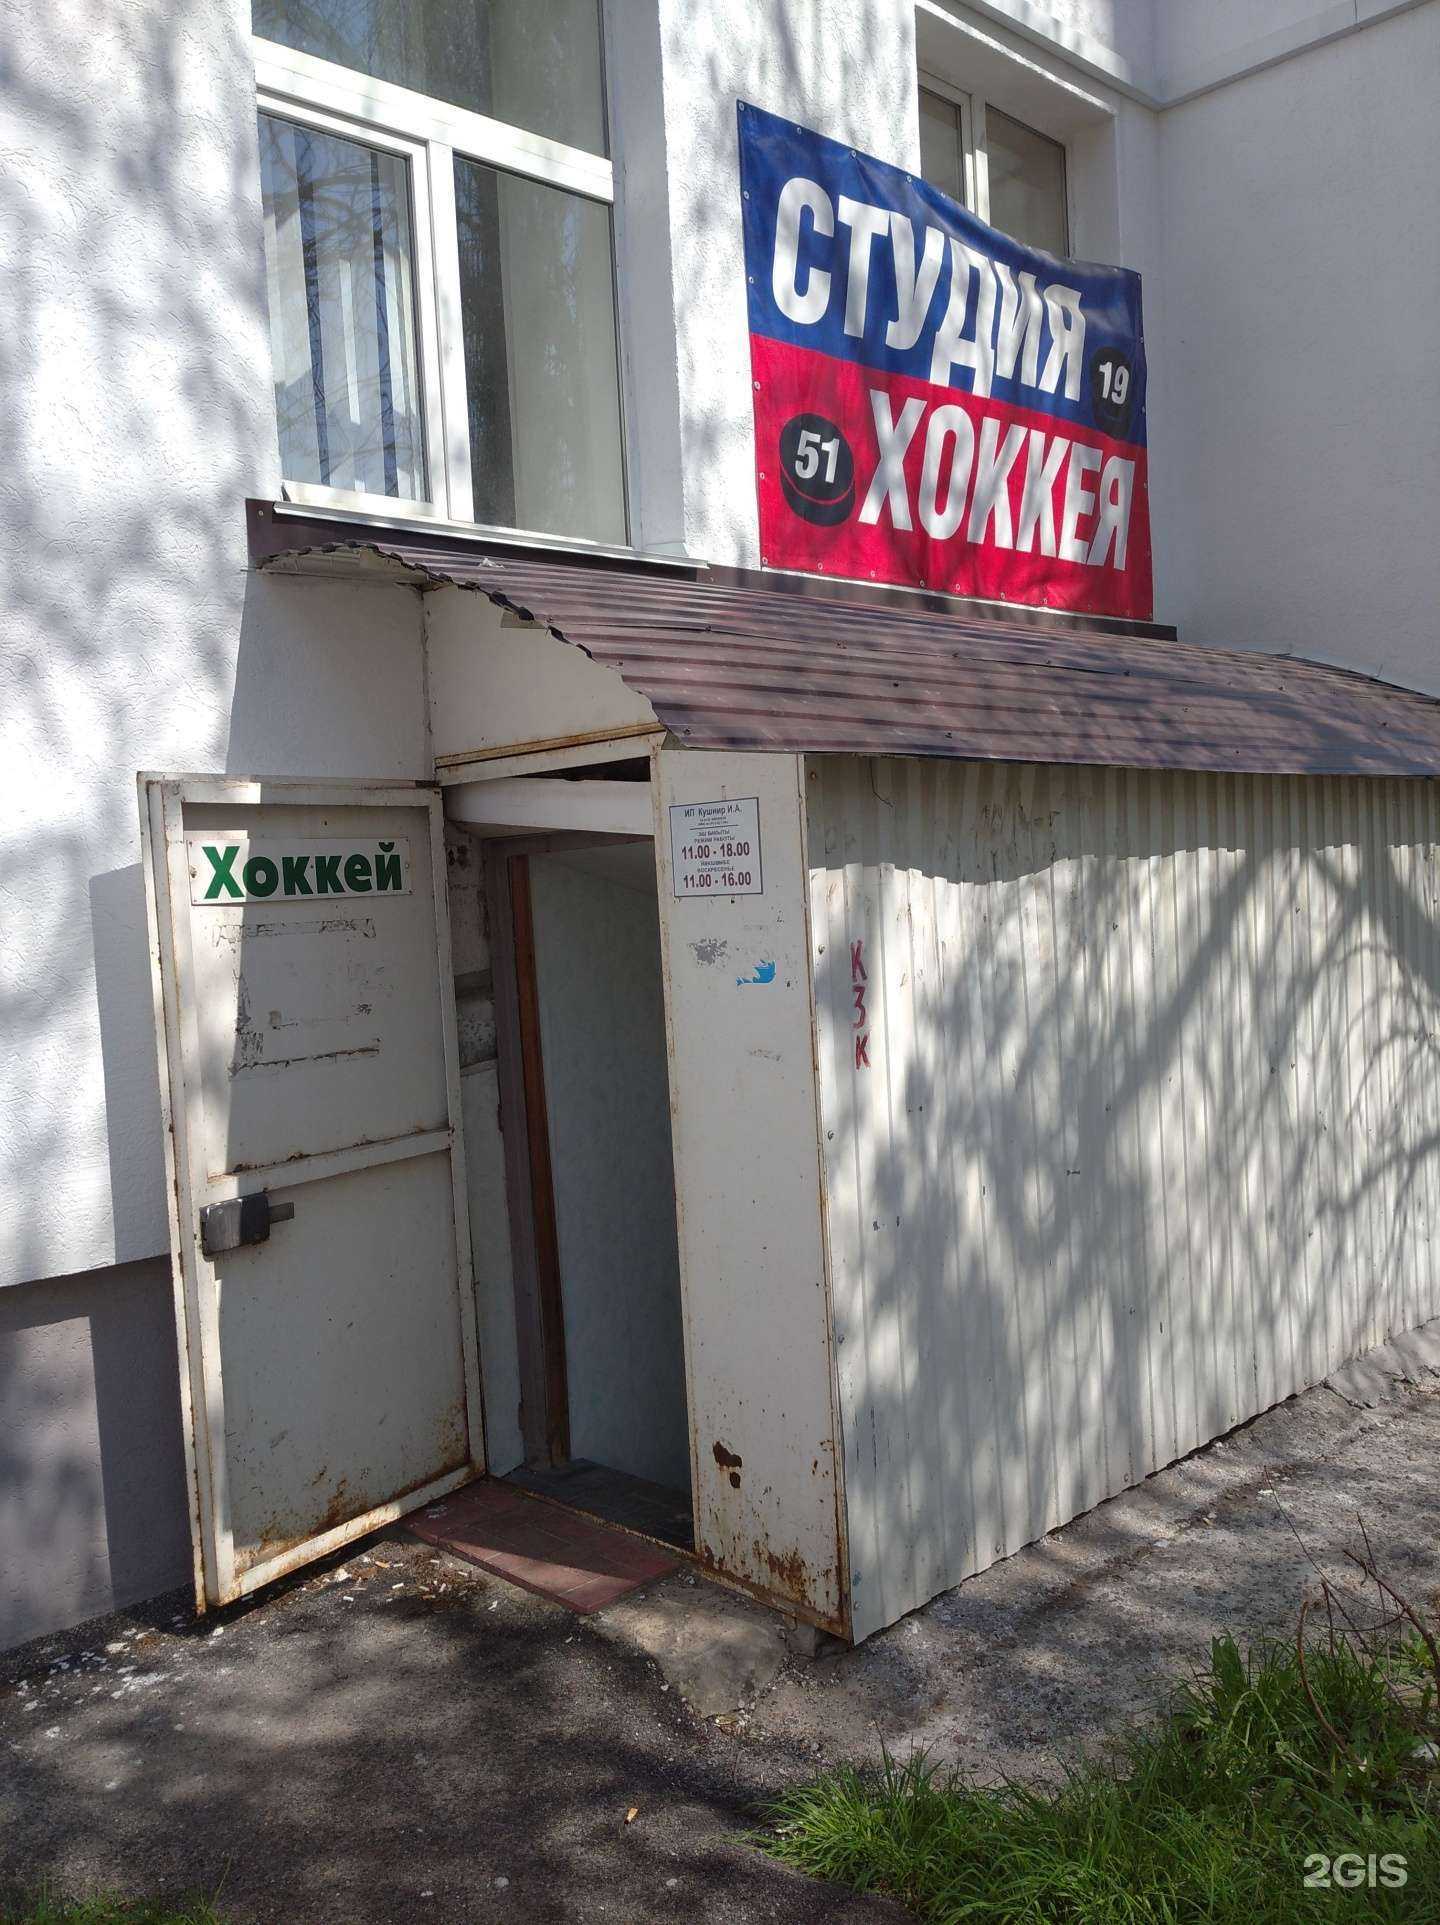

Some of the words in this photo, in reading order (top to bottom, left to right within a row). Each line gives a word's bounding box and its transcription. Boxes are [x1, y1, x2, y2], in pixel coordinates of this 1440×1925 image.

[771, 177, 1086, 401] СТУДИЯ
[1098, 361, 1130, 405] 19
[794, 429, 839, 484] 51
[857, 389, 1135, 571] ХОККЕЯ
[684, 810, 695, 818] ИП
[201, 841, 403, 900] Хоккей
[681, 845, 710, 860] 11.00
[720, 842, 750, 857] 18.00
[683, 874, 711, 889] 11.00
[721, 871, 751, 886] 16.00
